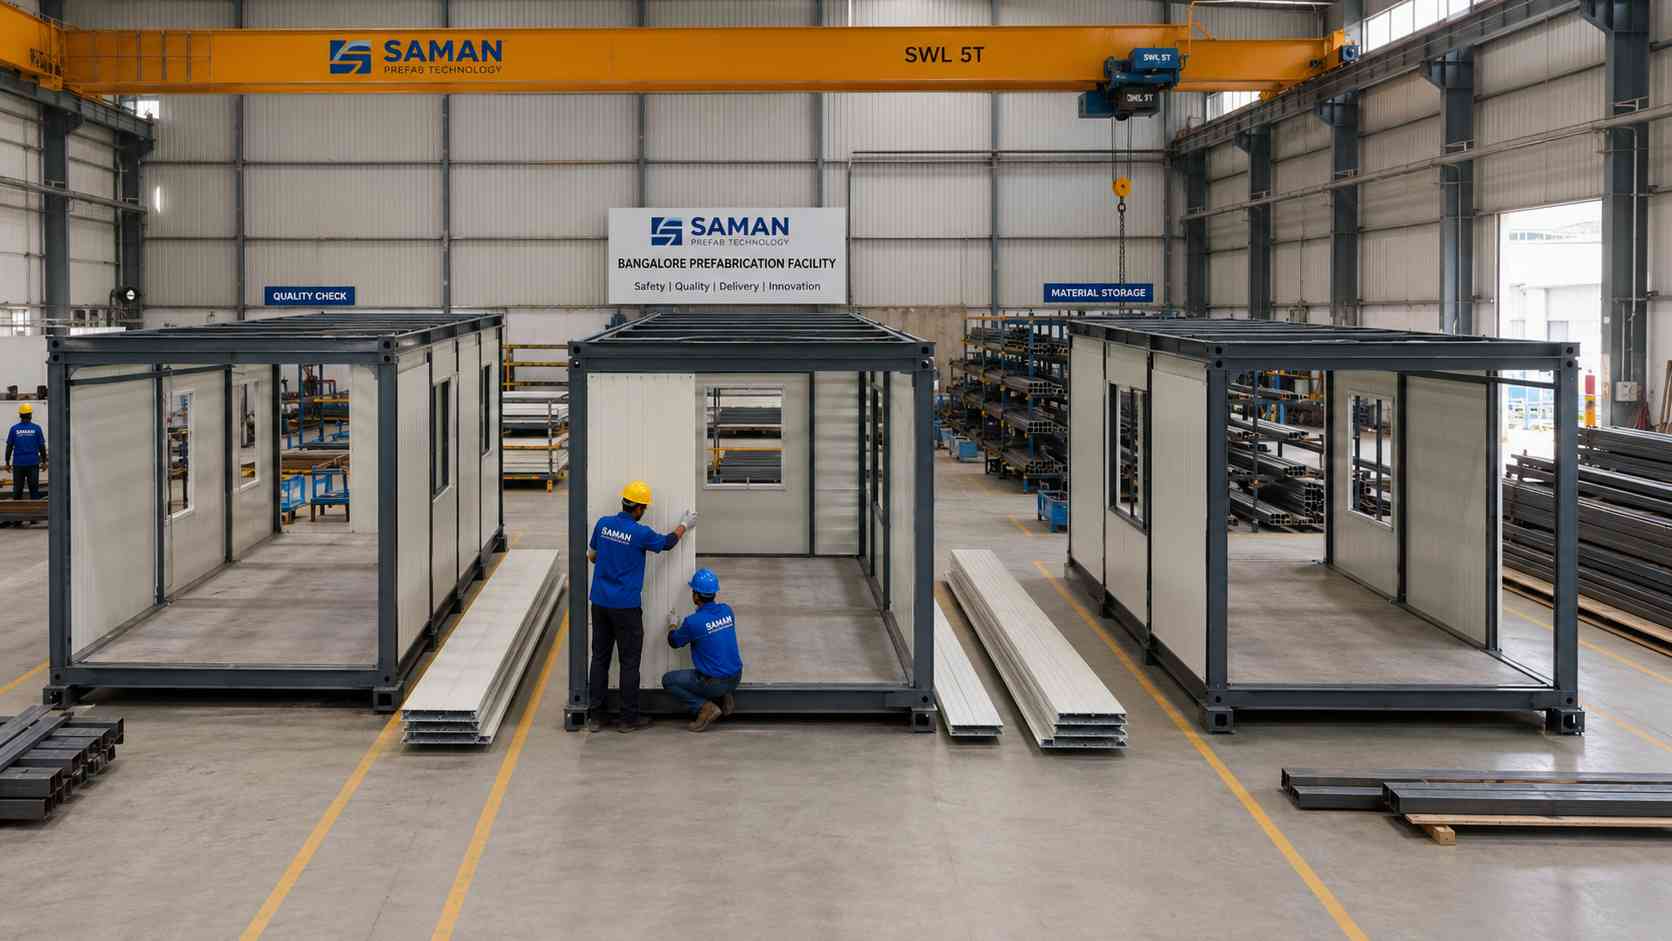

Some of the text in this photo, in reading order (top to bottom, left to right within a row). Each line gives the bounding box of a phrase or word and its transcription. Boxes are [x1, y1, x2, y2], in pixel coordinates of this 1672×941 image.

[383, 40, 503, 62] SAMAN
[905, 46, 985, 63] SWL 5T
[429, 65, 502, 74] TECHNOLOGY
[690, 216, 790, 236] SAMAN
[690, 239, 790, 247] PREFAB TECHNOLOGY
[618, 258, 837, 269] BANGALORE PREFABRICATION FACILITY
[634, 281, 666, 293] Safety
[675, 281, 710, 293] Quality
[720, 281, 760, 293] Delivery
[769, 281, 821, 291] Innovation
[1051, 288, 1146, 297] MATERIAL STORAGE
[273, 292, 347, 301] QUALITY CHECK
[601, 526, 632, 542] SAMAN
[705, 615, 732, 631] SAMAN
